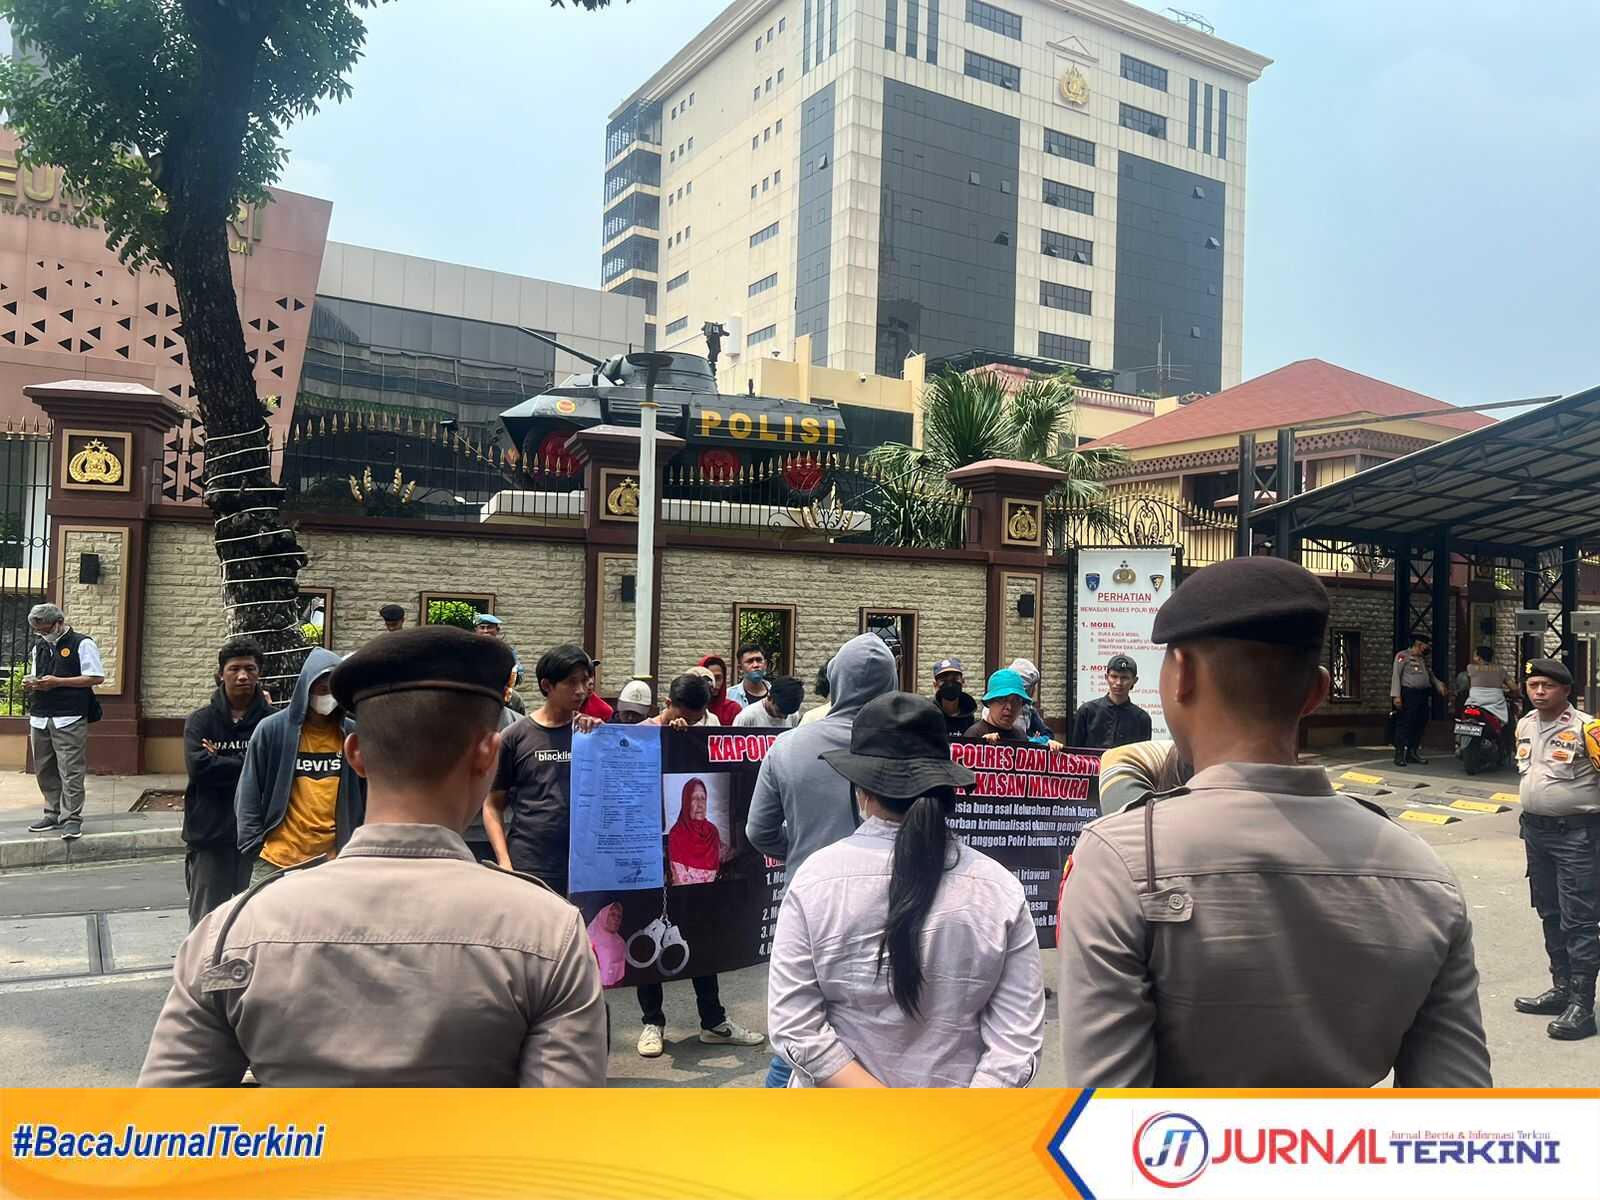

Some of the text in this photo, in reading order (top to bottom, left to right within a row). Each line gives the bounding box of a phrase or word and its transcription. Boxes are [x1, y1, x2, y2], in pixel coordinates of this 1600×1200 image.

[701, 410, 837, 446] POLISI
[1097, 592, 1152, 602] PERHATIAN
[1550, 739, 1575, 751] POLRI
[949, 742, 1015, 771] POLRES
[1015, 746, 1047, 773] DAN
[968, 771, 1027, 798] KASAN
[1027, 774, 1090, 801] MADURA
[973, 802, 994, 815] buta
[994, 803, 1013, 816] asal
[1013, 803, 1052, 817] Kelurahan
[978, 818, 1032, 831] kriminalisasi
[971, 835, 1007, 847] anggota
[1007, 835, 1027, 847] Polri
[1027, 835, 1058, 848] bernama
